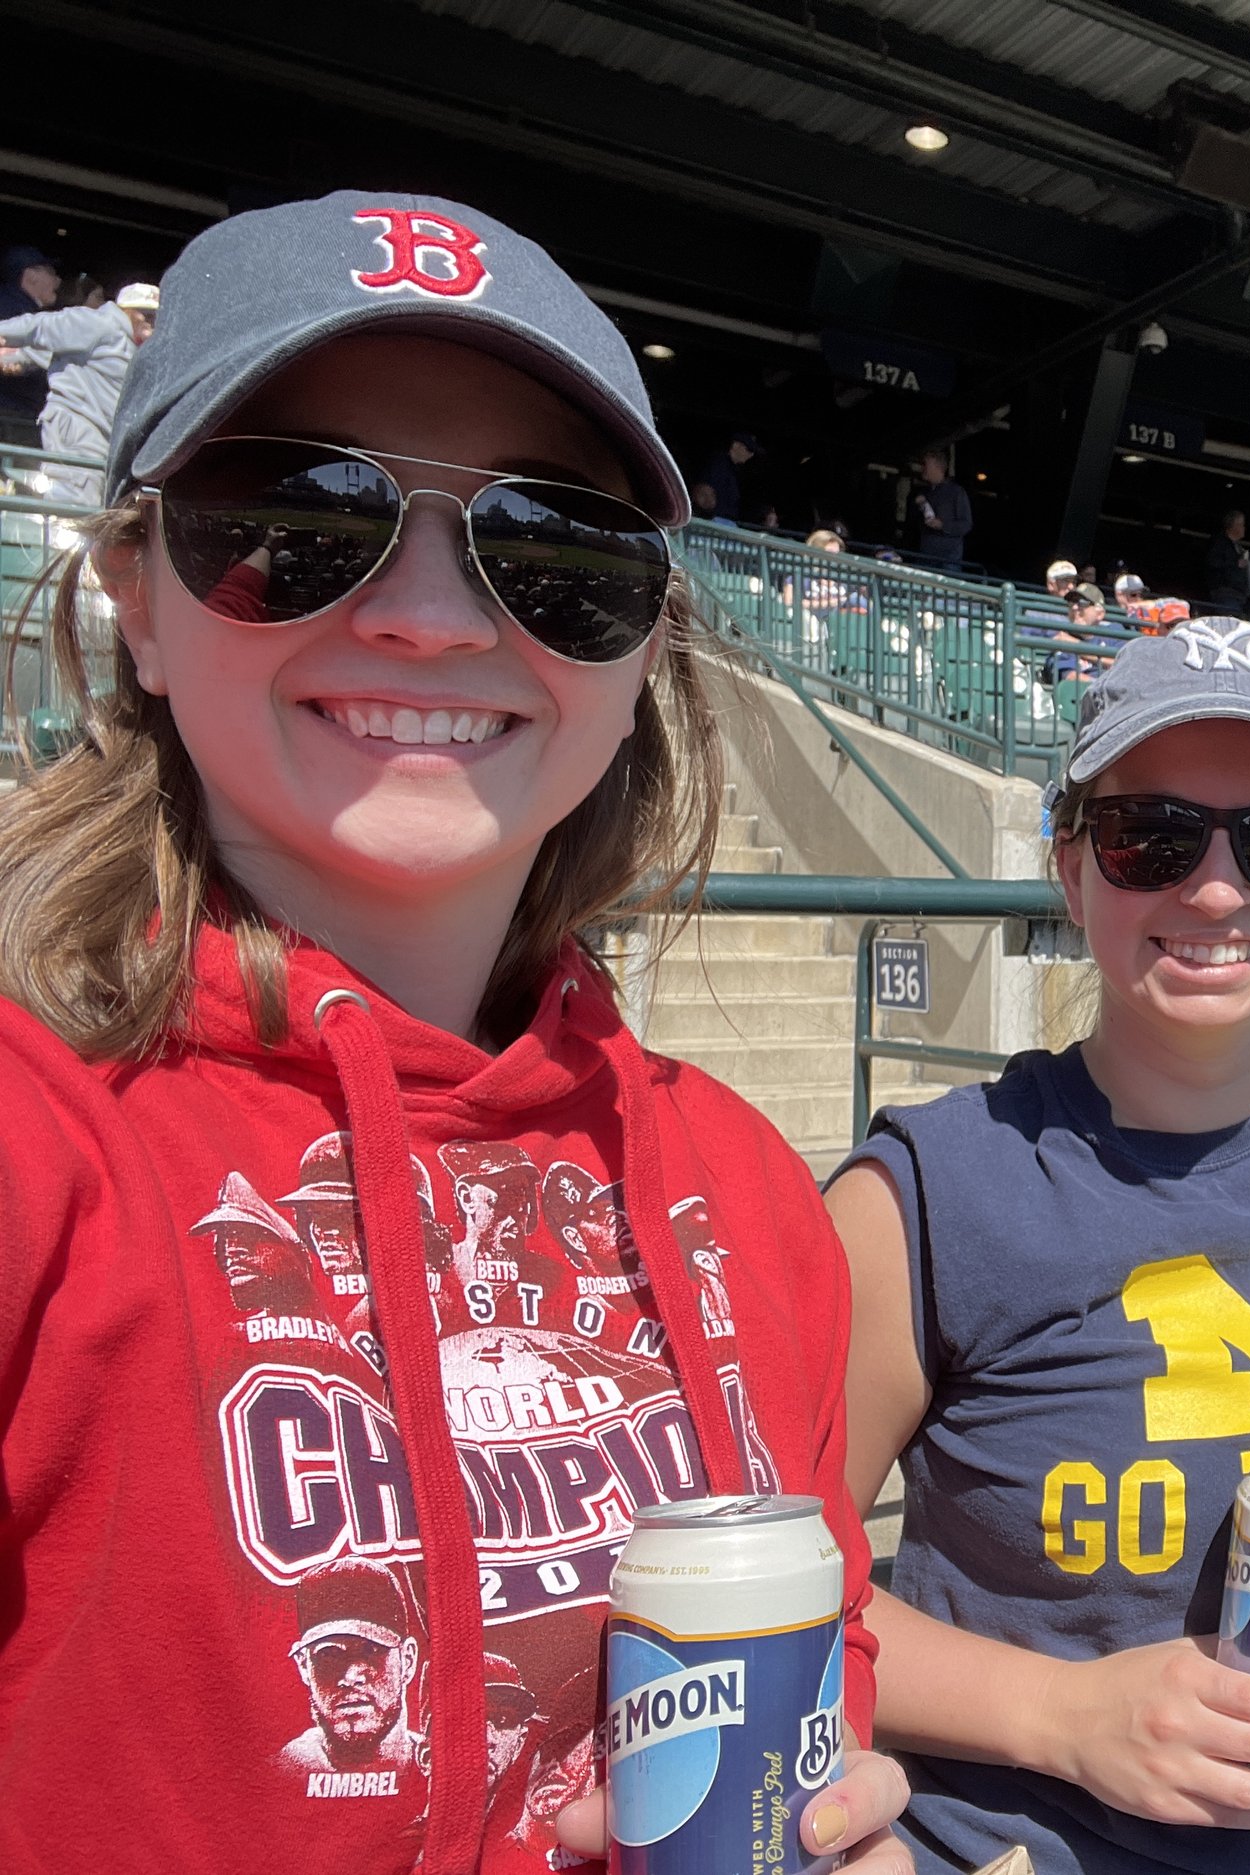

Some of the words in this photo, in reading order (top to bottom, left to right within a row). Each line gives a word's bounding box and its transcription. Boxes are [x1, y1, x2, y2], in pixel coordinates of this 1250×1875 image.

[350, 208, 493, 302] B
[862, 360, 901, 387] 137
[1127, 422, 1159, 446] 137
[882, 947, 918, 960] SECTION
[880, 963, 921, 1004] 136
[477, 1259, 520, 1282] BETTS
[576, 1272, 650, 1296] BOGAERTS
[1042, 1458, 1188, 1576] GO
[624, 1671, 740, 1745] MOON
[306, 1771, 399, 1798] KIMBREL
[752, 1789, 764, 1833] WITH
